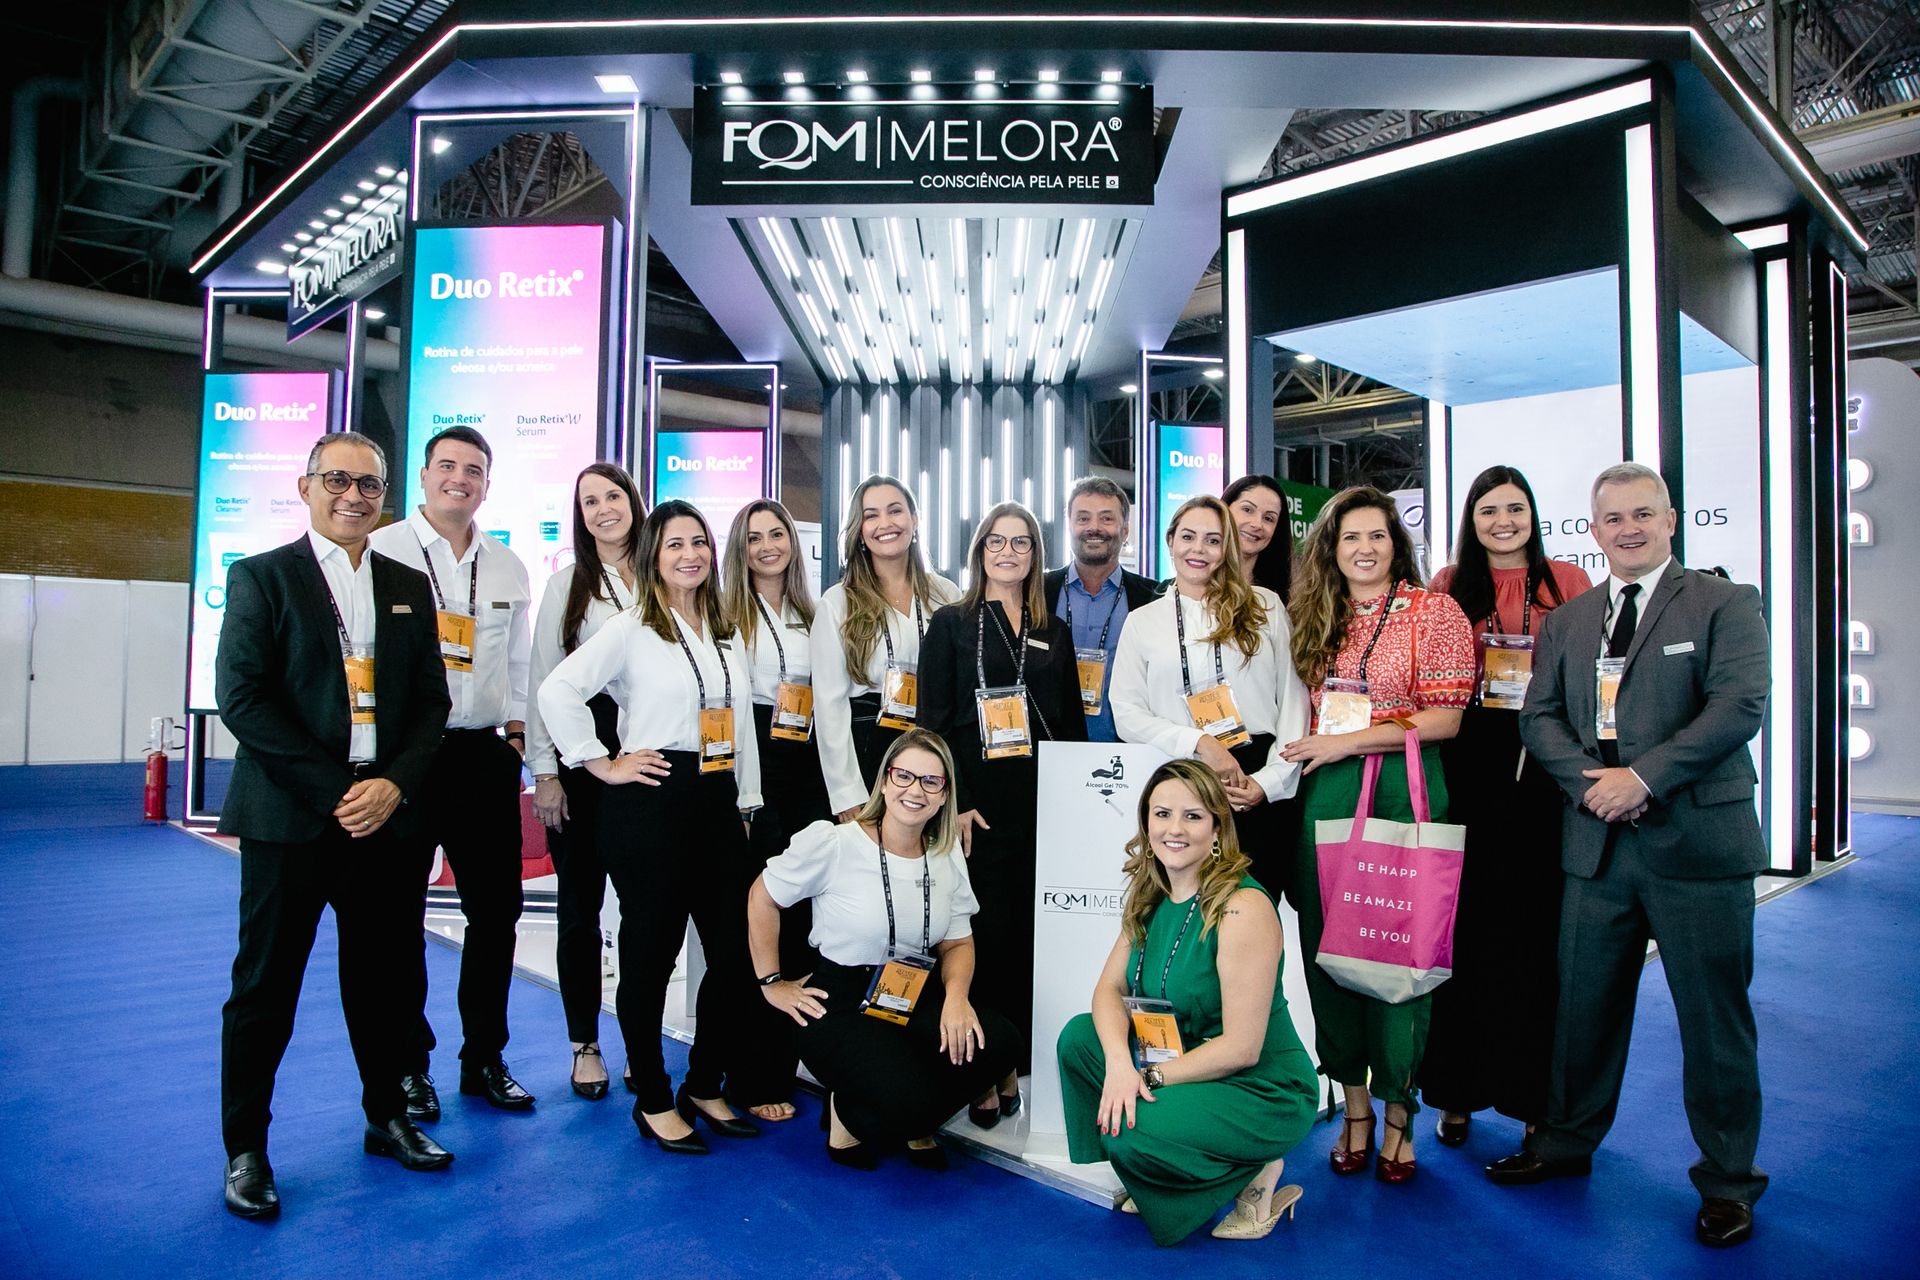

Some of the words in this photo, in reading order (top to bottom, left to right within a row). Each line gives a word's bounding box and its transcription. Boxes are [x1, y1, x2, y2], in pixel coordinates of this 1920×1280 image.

[722, 119, 866, 170] FQM
[920, 172, 1025, 189] CONSCIÊNCIA
[1030, 175, 1065, 189] PELA
[1068, 175, 1100, 189] PELE
[430, 273, 492, 300] Duo
[424, 346, 458, 358] Rotina
[460, 346, 475, 357] de
[477, 345, 524, 357] cuidados
[526, 346, 549, 359] para
[560, 344, 584, 359] pele
[450, 362, 486, 374] oleosa
[214, 401, 256, 421] Duo
[433, 414, 454, 424] Duo
[517, 414, 537, 425] Duo
[667, 455, 702, 472] Duo
[1170, 450, 1205, 467] Duo
[1695, 507, 1728, 526] os
[1358, 861, 1375, 873] BE
[1044, 892, 1087, 910] FQM
[1343, 891, 1361, 904] BE
[1359, 927, 1376, 938] BE
[1381, 931, 1411, 943] YOU
